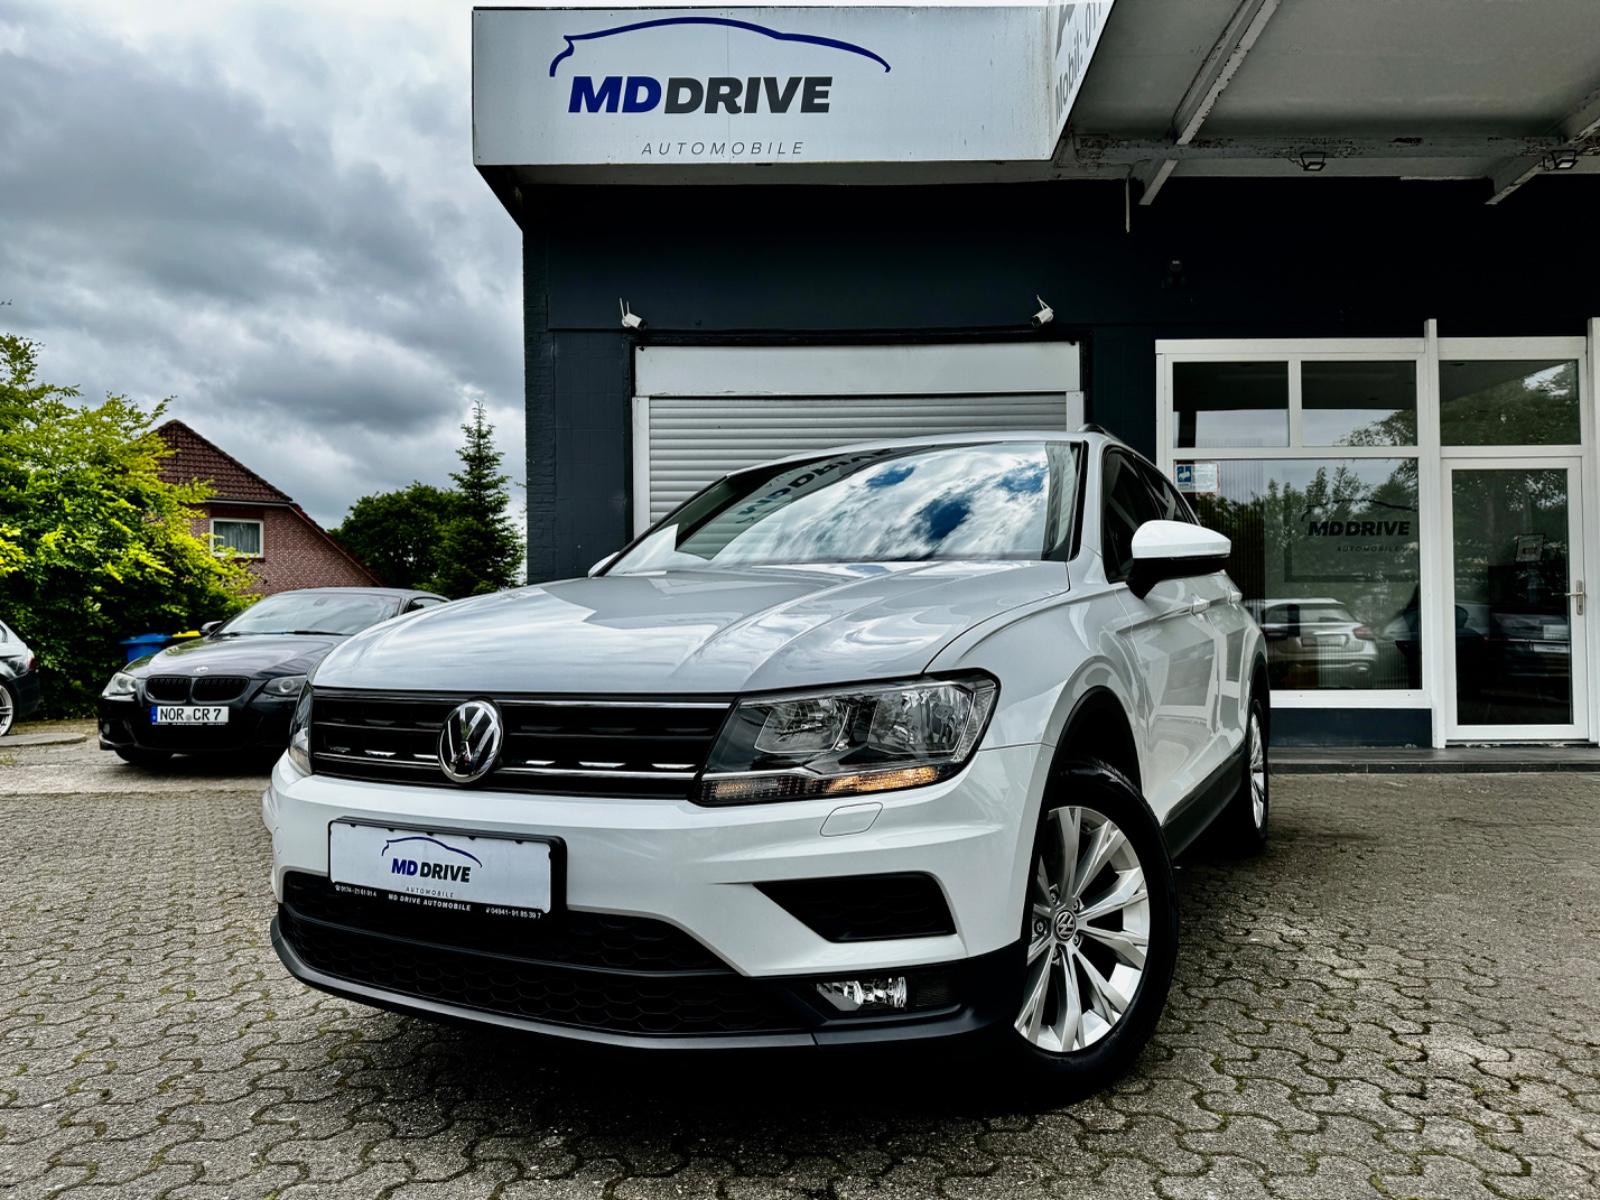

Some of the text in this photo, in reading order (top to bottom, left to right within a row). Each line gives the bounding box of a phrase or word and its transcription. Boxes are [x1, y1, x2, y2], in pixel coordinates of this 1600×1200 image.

[641, 142, 804, 155] AUTOMOBILE
[160, 708, 184, 721] NOR
[406, 886, 454, 898] AUTOMOBILE
[400, 895, 421, 905] DRIVE
[423, 899, 471, 911] AUTOMOBILE
